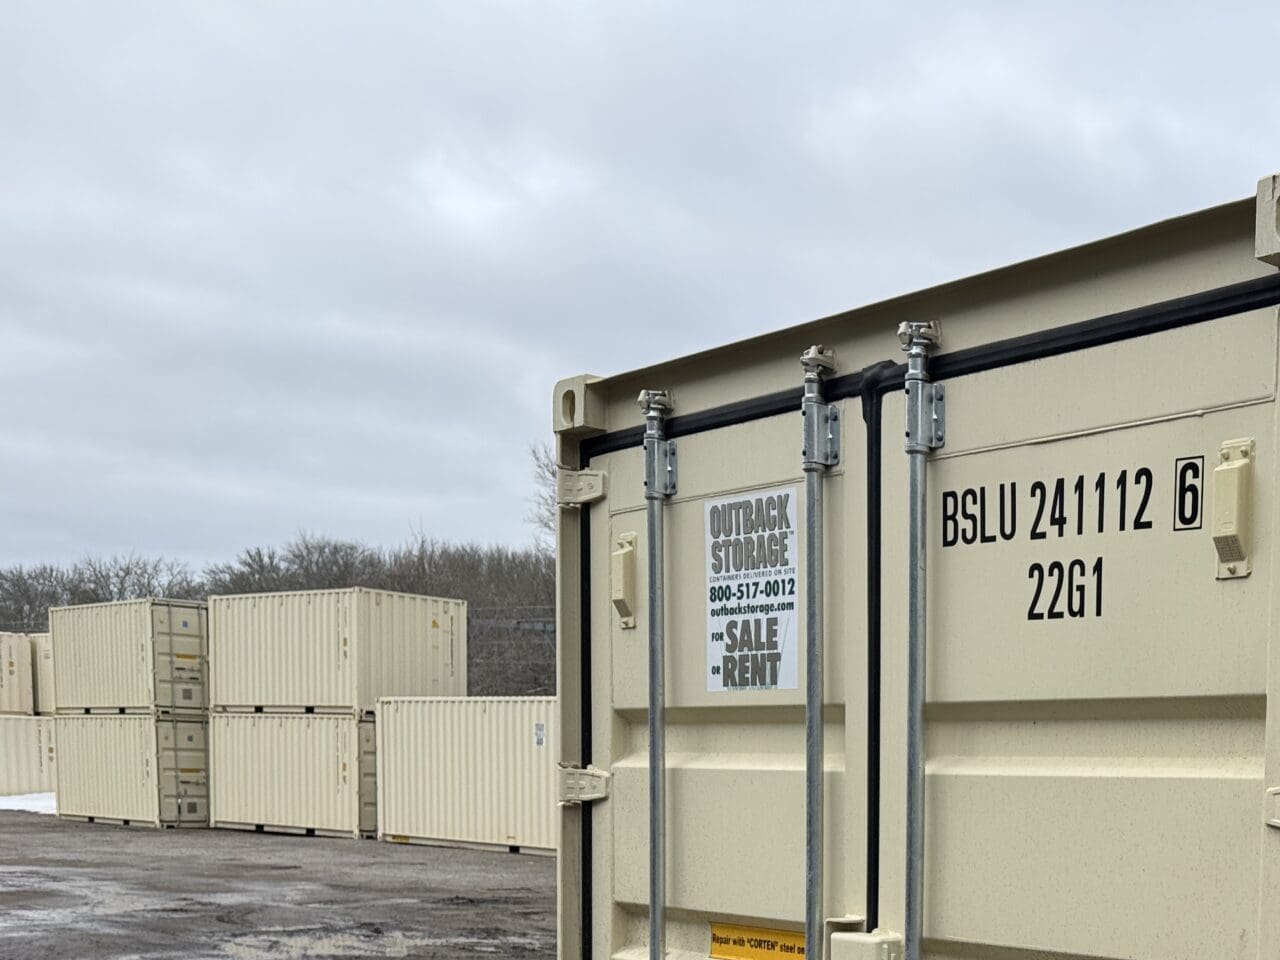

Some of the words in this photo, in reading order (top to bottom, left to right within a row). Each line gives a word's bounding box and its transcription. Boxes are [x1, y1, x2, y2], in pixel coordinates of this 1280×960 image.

[710, 494, 791, 539] OUTBACK
[942, 482, 1016, 547] BSLU
[1030, 467, 1153, 540] 241112
[1178, 461, 1200, 526] 6
[711, 531, 789, 574] STORAGE
[709, 574, 741, 583] CONTAINERS
[743, 570, 772, 579] DELIVERED
[709, 578, 795, 603] 800-517-0012
[1027, 557, 1103, 620] 22G1
[711, 602, 794, 617] outbackstorage.com
[712, 632, 724, 642] FOR
[725, 617, 778, 653] SALE
[712, 665, 720, 675] OR
[723, 653, 781, 687] RENT
[712, 933, 731, 946] Repair
[732, 937, 745, 947] with
[780, 942, 796, 953] steel
